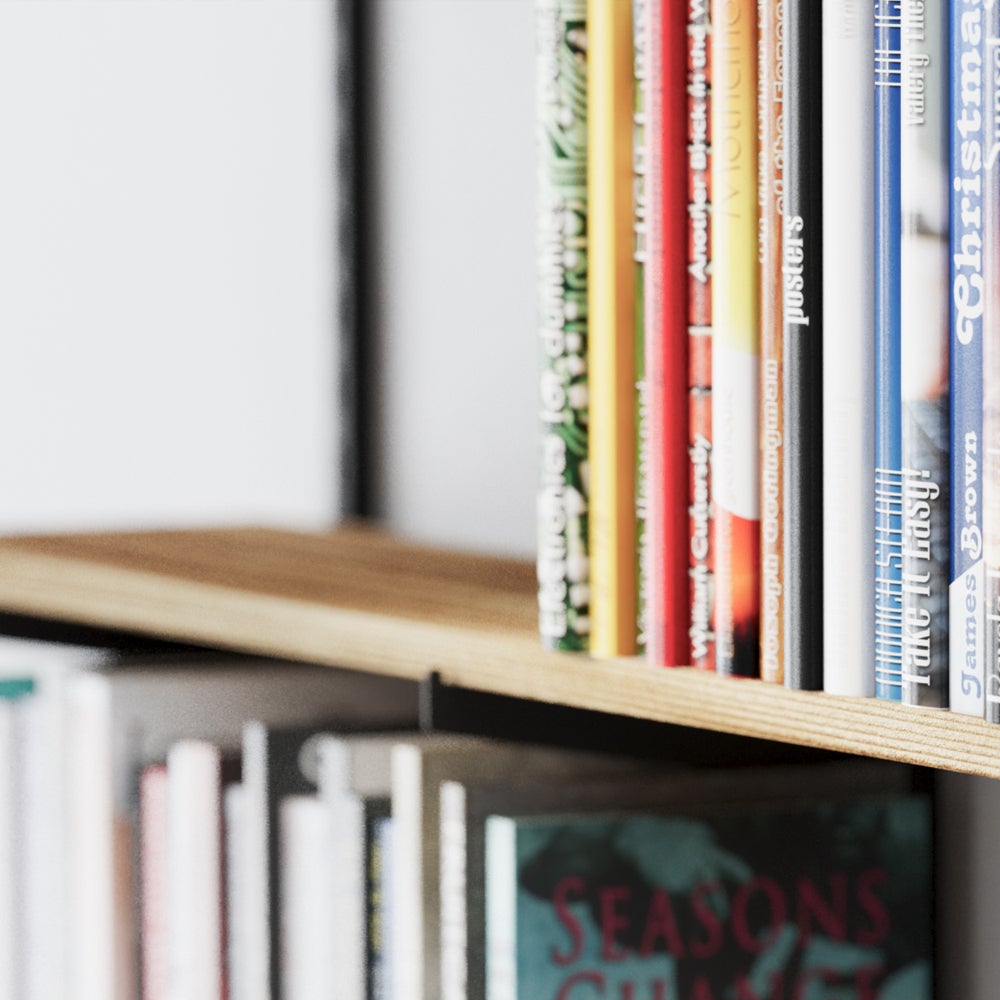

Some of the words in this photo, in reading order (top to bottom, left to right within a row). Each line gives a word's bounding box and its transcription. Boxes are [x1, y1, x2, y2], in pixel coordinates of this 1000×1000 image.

[953, 0, 985, 345] Christma
[689, 180, 709, 285] Another
[780, 216, 810, 326] posters
[902, 469, 940, 561] Easy!
[960, 430, 983, 561] Brown
[902, 571, 931, 598] It
[960, 574, 982, 700] James
[902, 607, 931, 688] Take
[551, 867, 891, 966] SEASONS
